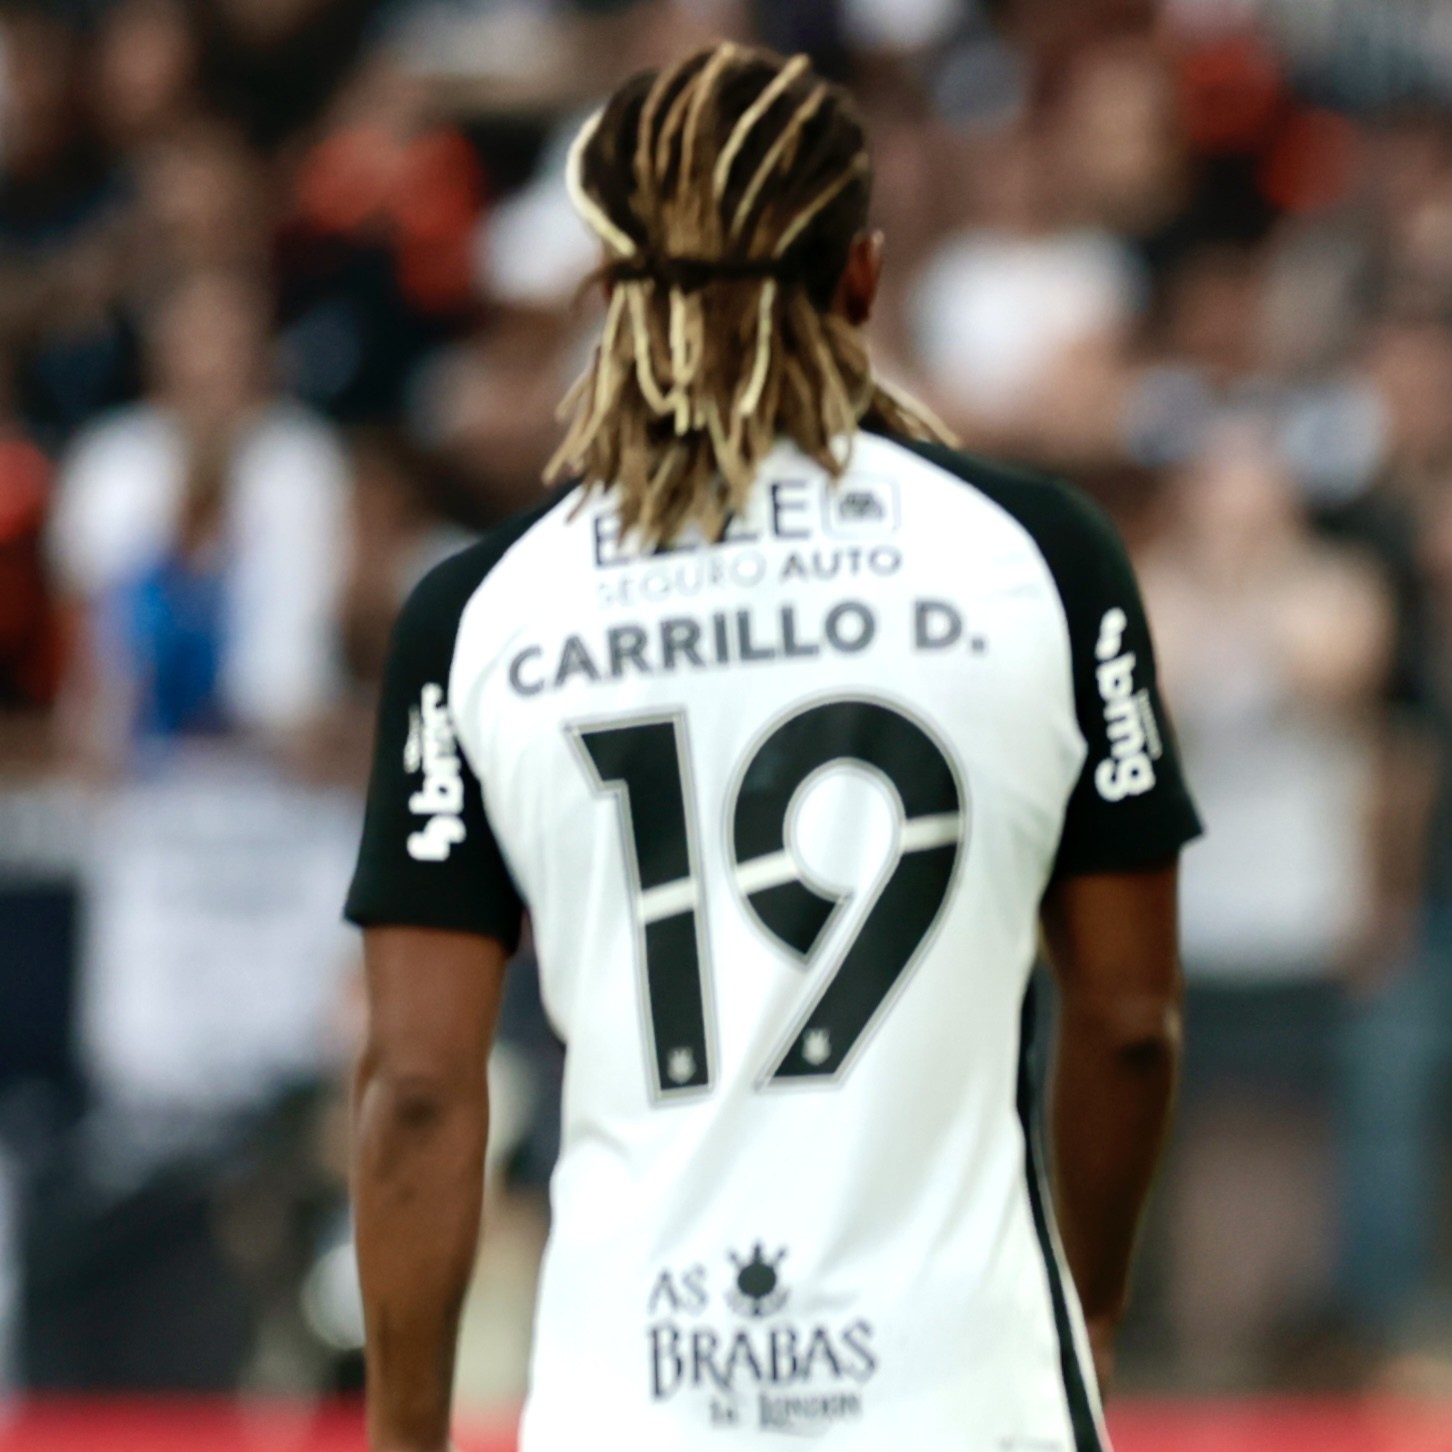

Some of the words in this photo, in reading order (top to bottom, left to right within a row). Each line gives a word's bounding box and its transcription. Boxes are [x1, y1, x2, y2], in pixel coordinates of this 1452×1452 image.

[778, 544, 902, 585] AUTO
[508, 600, 876, 697] CARRILLO
[912, 600, 986, 655] D.
[565, 690, 967, 1105] 19
[646, 1317, 878, 1403] BRABAS
